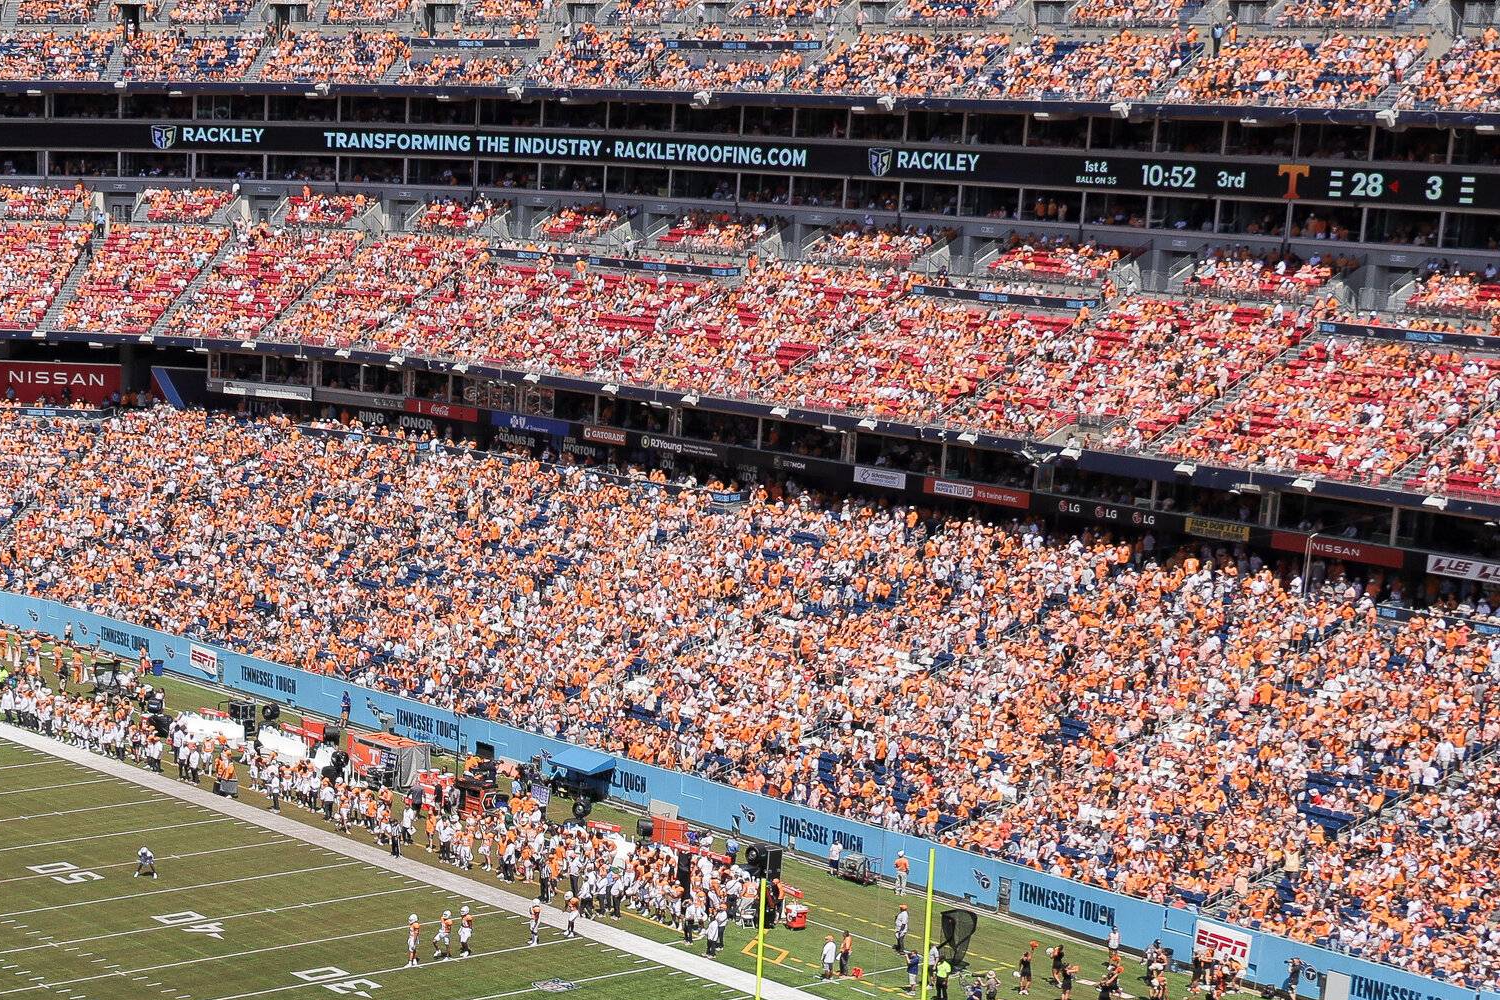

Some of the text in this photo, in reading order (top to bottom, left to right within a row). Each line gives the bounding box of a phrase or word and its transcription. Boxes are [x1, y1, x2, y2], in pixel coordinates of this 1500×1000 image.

[182, 127, 264, 144] RACKLEY
[324, 132, 807, 168] TRANSFORMING THE INDUSTRY RACKLEYROOFING.COM
[897, 151, 980, 172] RACKLEY
[1085, 161, 1108, 173] 1st &
[1076, 176, 1117, 185] BALL ON 35
[1142, 165, 1196, 188] 10:52
[1217, 171, 1245, 189] 3rd
[1278, 164, 1310, 199] T
[1350, 172, 1383, 198] 28
[1425, 176, 1442, 200] 3
[9, 370, 104, 387] NISSAN
[359, 410, 384, 424] RING
[499, 433, 526, 446] ADAMS
[592, 430, 625, 442] GATORADE
[563, 443, 596, 457] NORTON
[783, 460, 806, 470] BETMGM
[1069, 503, 1080, 513] LG
[1106, 508, 1117, 519] LG
[1143, 515, 1155, 525] LG
[1231, 525, 1244, 533] LET
[1311, 542, 1360, 557] NISSAN
[1448, 560, 1473, 572] LEE
[101, 626, 149, 656] TENNESSEE TOUGH
[191, 649, 216, 669] ESPN
[241, 666, 296, 694] TENNESSEE TOUGH
[396, 708, 435, 732] TENNESSEE
[369, 749, 380, 766] T
[779, 815, 863, 853] TENNESSEE TOUGH
[25, 861, 104, 884] 50
[1019, 881, 1116, 927] TENNESSEE TOUGH
[151, 911, 225, 939] 40
[1197, 930, 1249, 958] ESPN
[291, 966, 383, 995] 30
